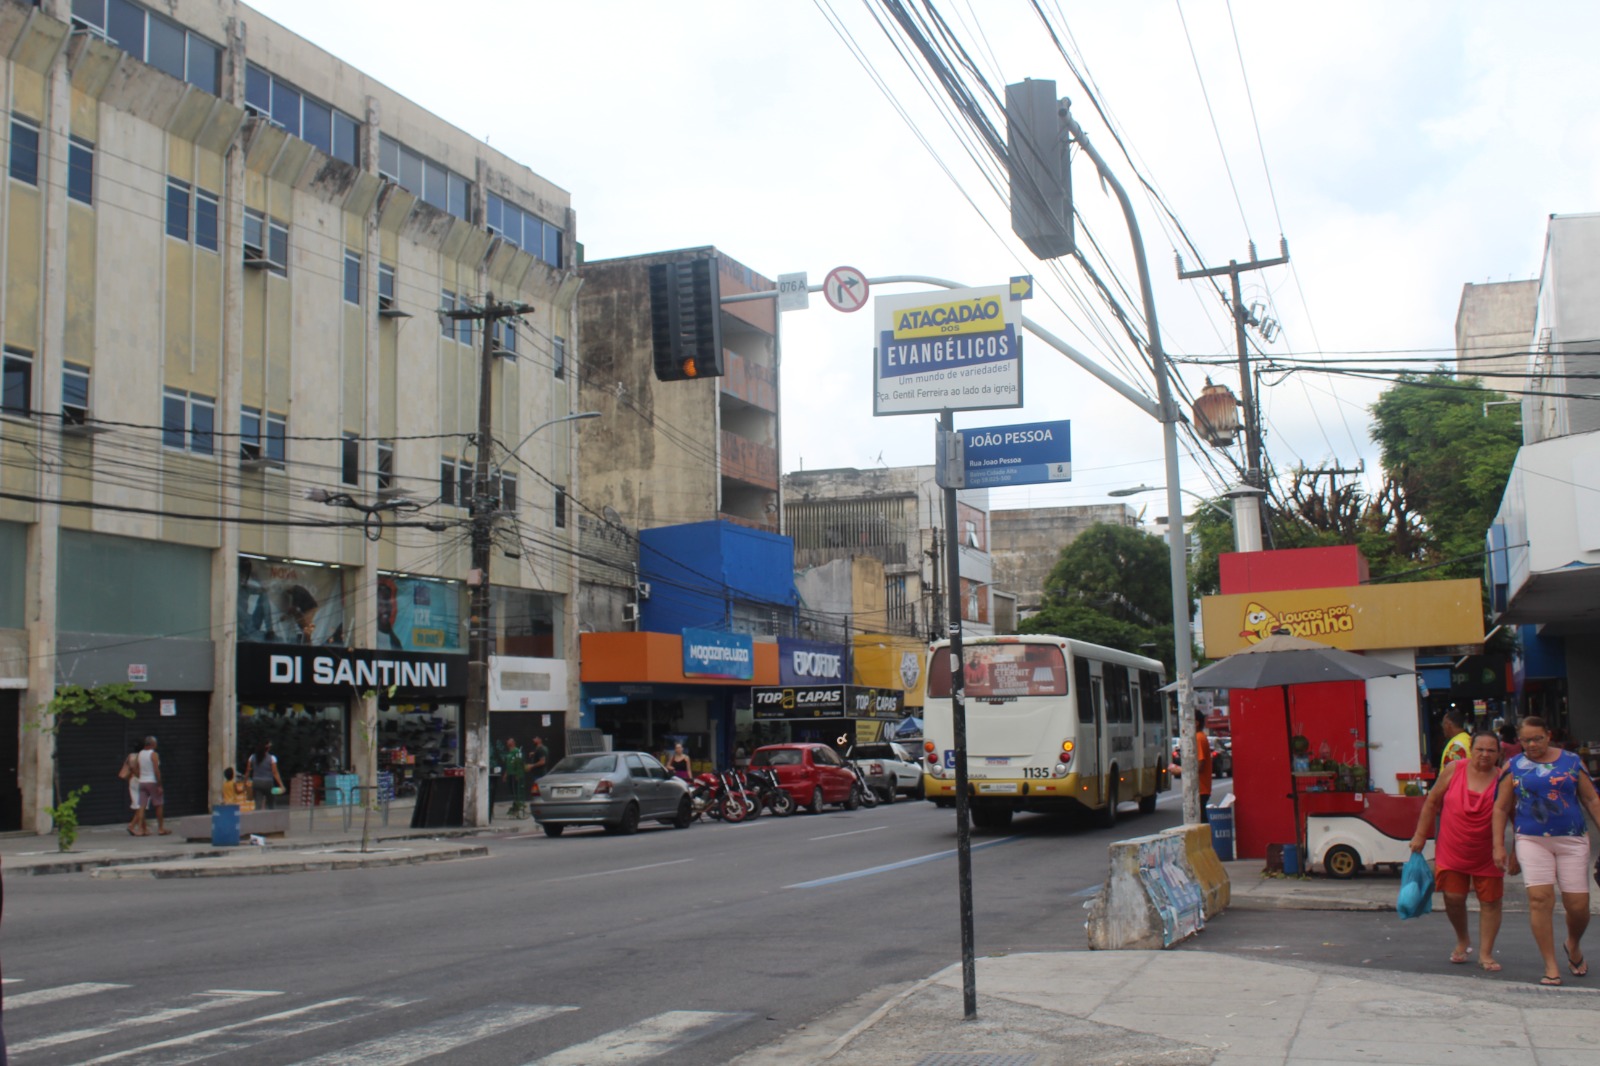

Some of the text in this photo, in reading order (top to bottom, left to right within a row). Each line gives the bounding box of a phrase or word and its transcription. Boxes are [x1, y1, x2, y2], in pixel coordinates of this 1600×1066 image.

[898, 298, 1000, 331] ATACADÃO
[941, 324, 960, 333] DOS
[888, 335, 1009, 367] EVANGÉLICOS
[898, 362, 1011, 386] Um mundo de variedades!
[893, 390, 915, 400] Gentil
[917, 387, 949, 399] Ferreira
[951, 388, 960, 396] ao
[963, 386, 979, 395] lado
[981, 385, 992, 394] da
[993, 383, 1018, 396] igreja.
[968, 429, 1053, 448] JOÃO PESSOA
[969, 459, 982, 467] Rua
[999, 457, 1022, 465] Pessoa
[986, 468, 1006, 476] Cidade
[1006, 467, 1018, 475] Alta
[1279, 605, 1348, 624] Loucos por
[270, 654, 447, 687] DI SANTINNI
[994, 669, 1030, 677] ETERNIT
[756, 690, 841, 704] TOP CAPAS
[856, 695, 897, 711] TOP CAPAS
[1022, 767, 1050, 778] 1135
